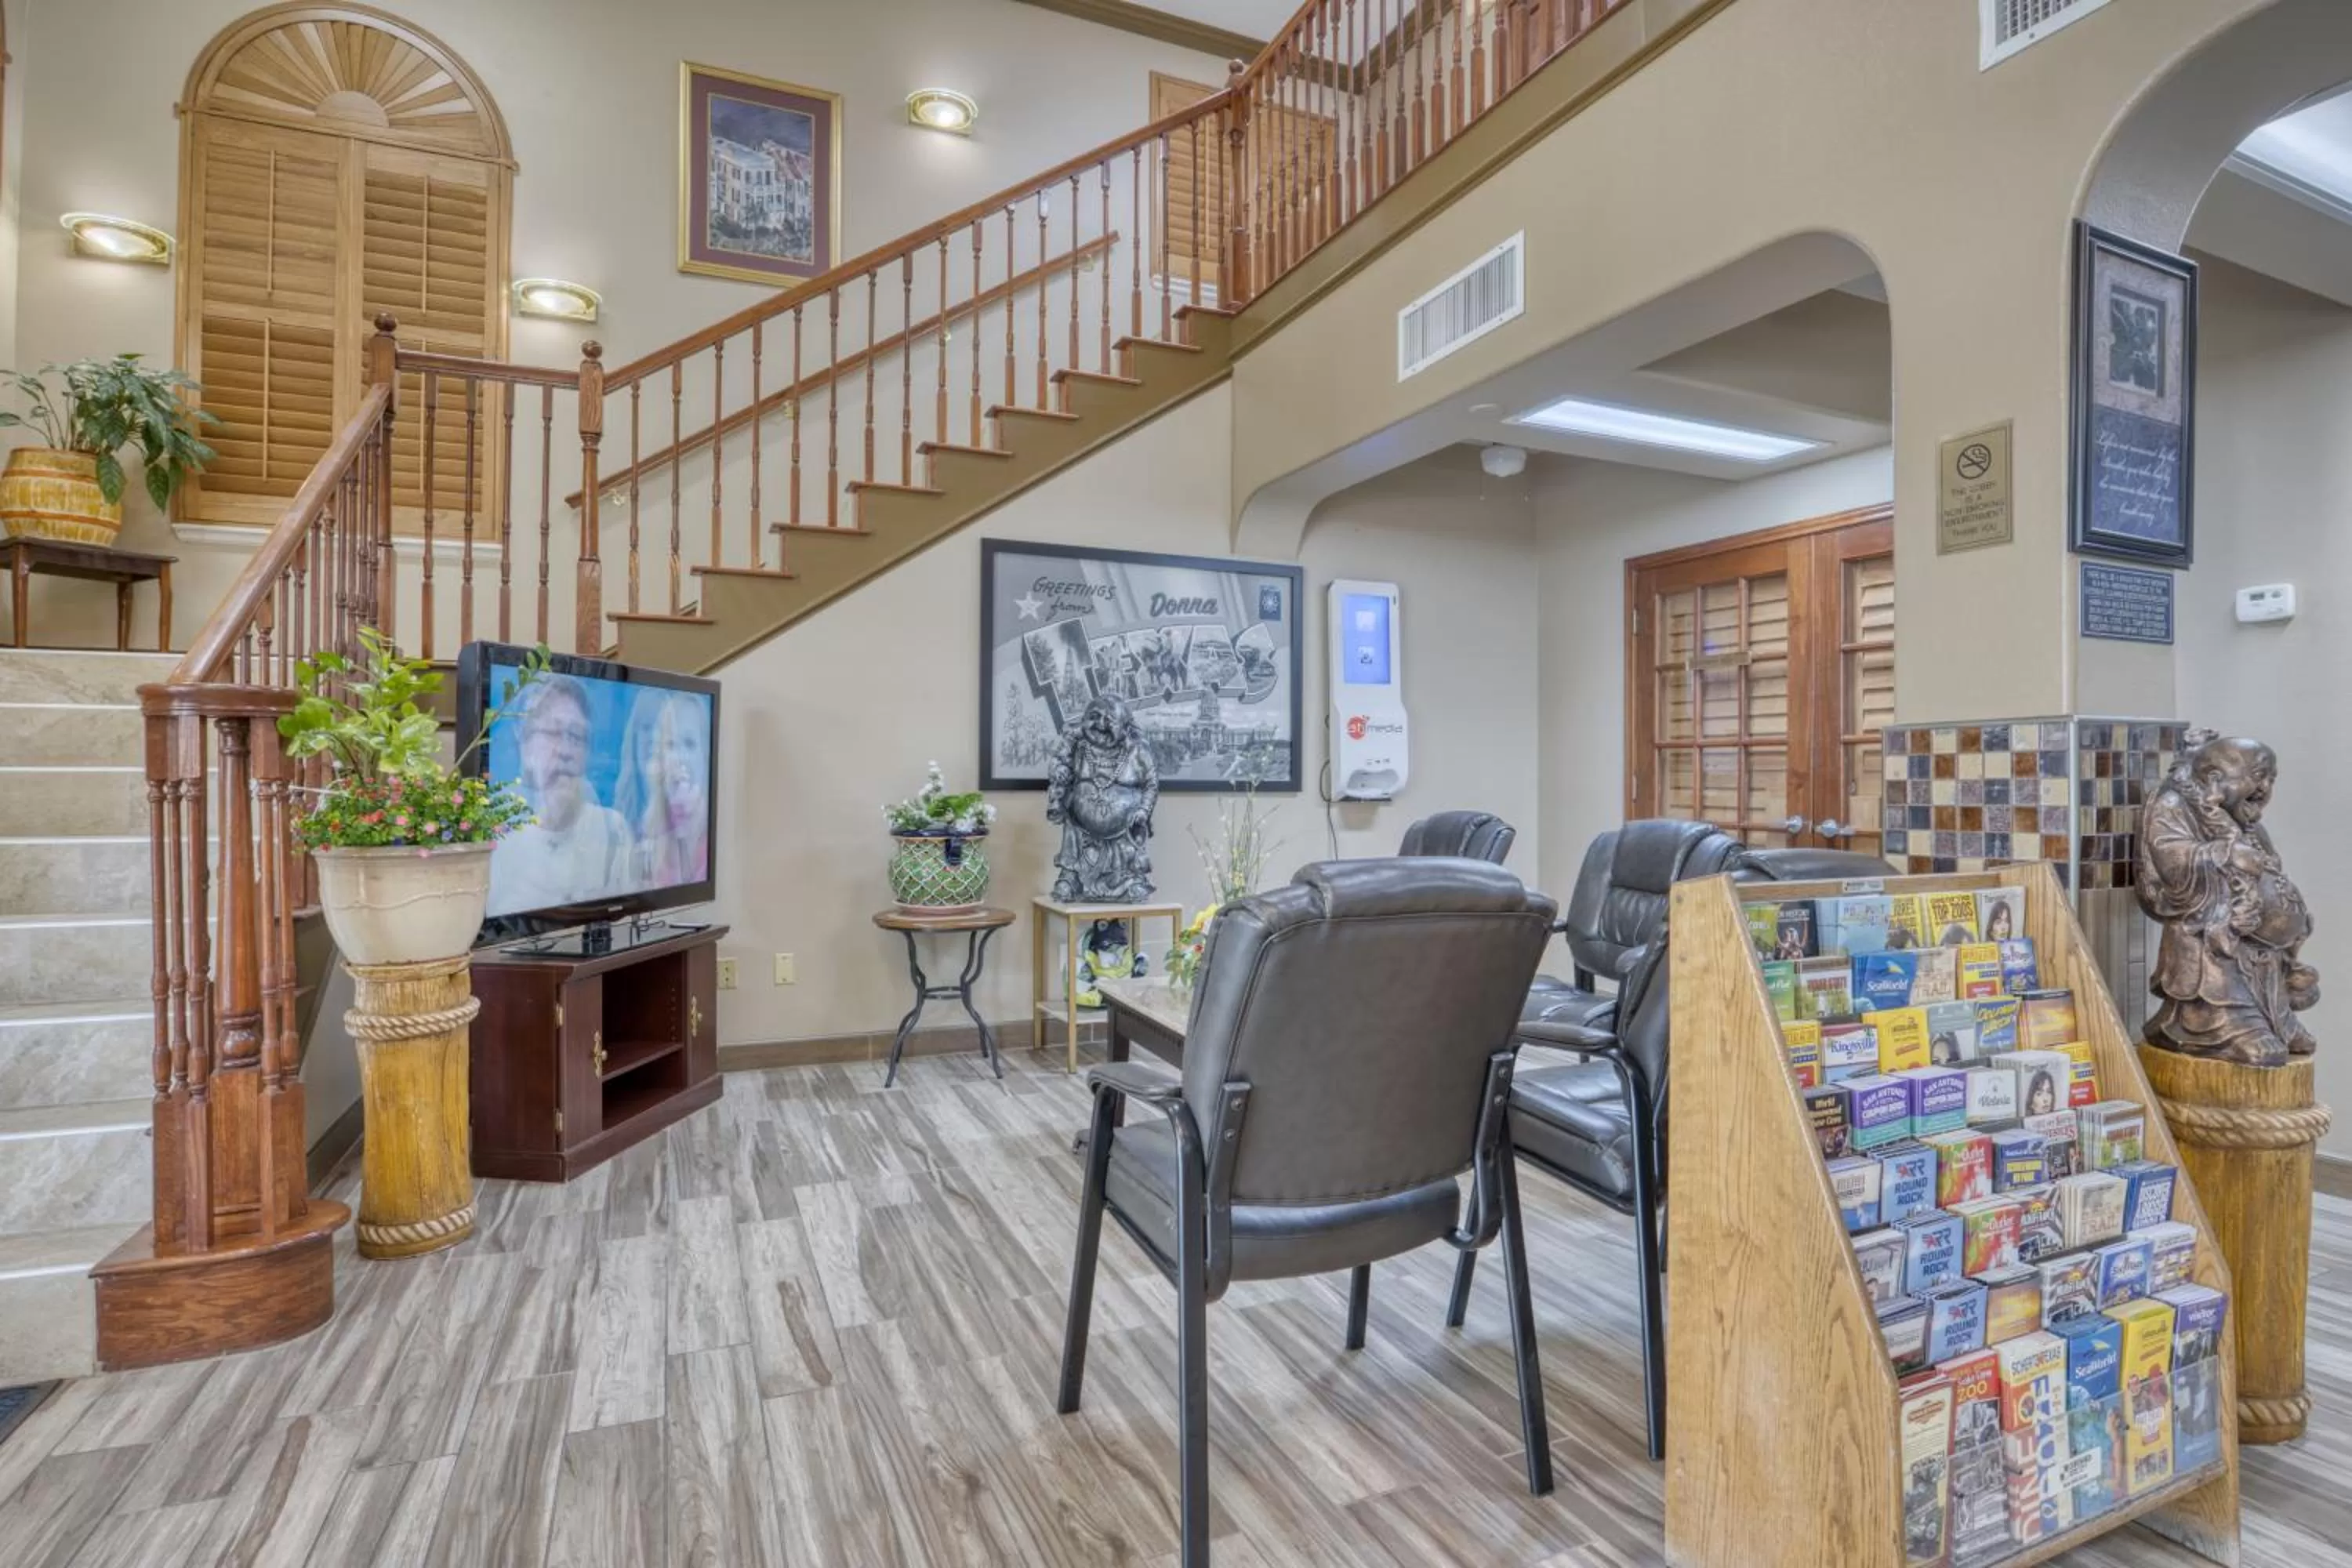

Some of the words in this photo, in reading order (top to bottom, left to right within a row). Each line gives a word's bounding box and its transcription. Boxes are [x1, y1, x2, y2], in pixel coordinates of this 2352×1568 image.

[1032, 576, 1116, 601] GREETINGS
[1045, 597, 1096, 622] from
[1149, 592, 1218, 617] Donna
[1021, 615, 1279, 729] TEXAS
[1950, 901, 1974, 919] ZOOS
[1866, 977, 1908, 993] SeaWorld
[1831, 1036, 1876, 1054] Kingsville
[1923, 1082, 1938, 1094] SAN
[1937, 1077, 1965, 1090] ANTONIO
[1862, 1091, 1878, 1109] SAN
[1878, 1086, 1908, 1100] ANTONIO
[1894, 1177, 1929, 1193] ROUND
[1896, 1192, 1925, 1206] ROCK
[1920, 1246, 1955, 1265] ROUND
[1922, 1261, 1949, 1277] ROCK
[1944, 1316, 1978, 1337] ROUND
[1946, 1333, 1972, 1348] ROCK
[2074, 1352, 2117, 1380] SeaWorld
[1956, 1380, 1987, 1403] ZOO
